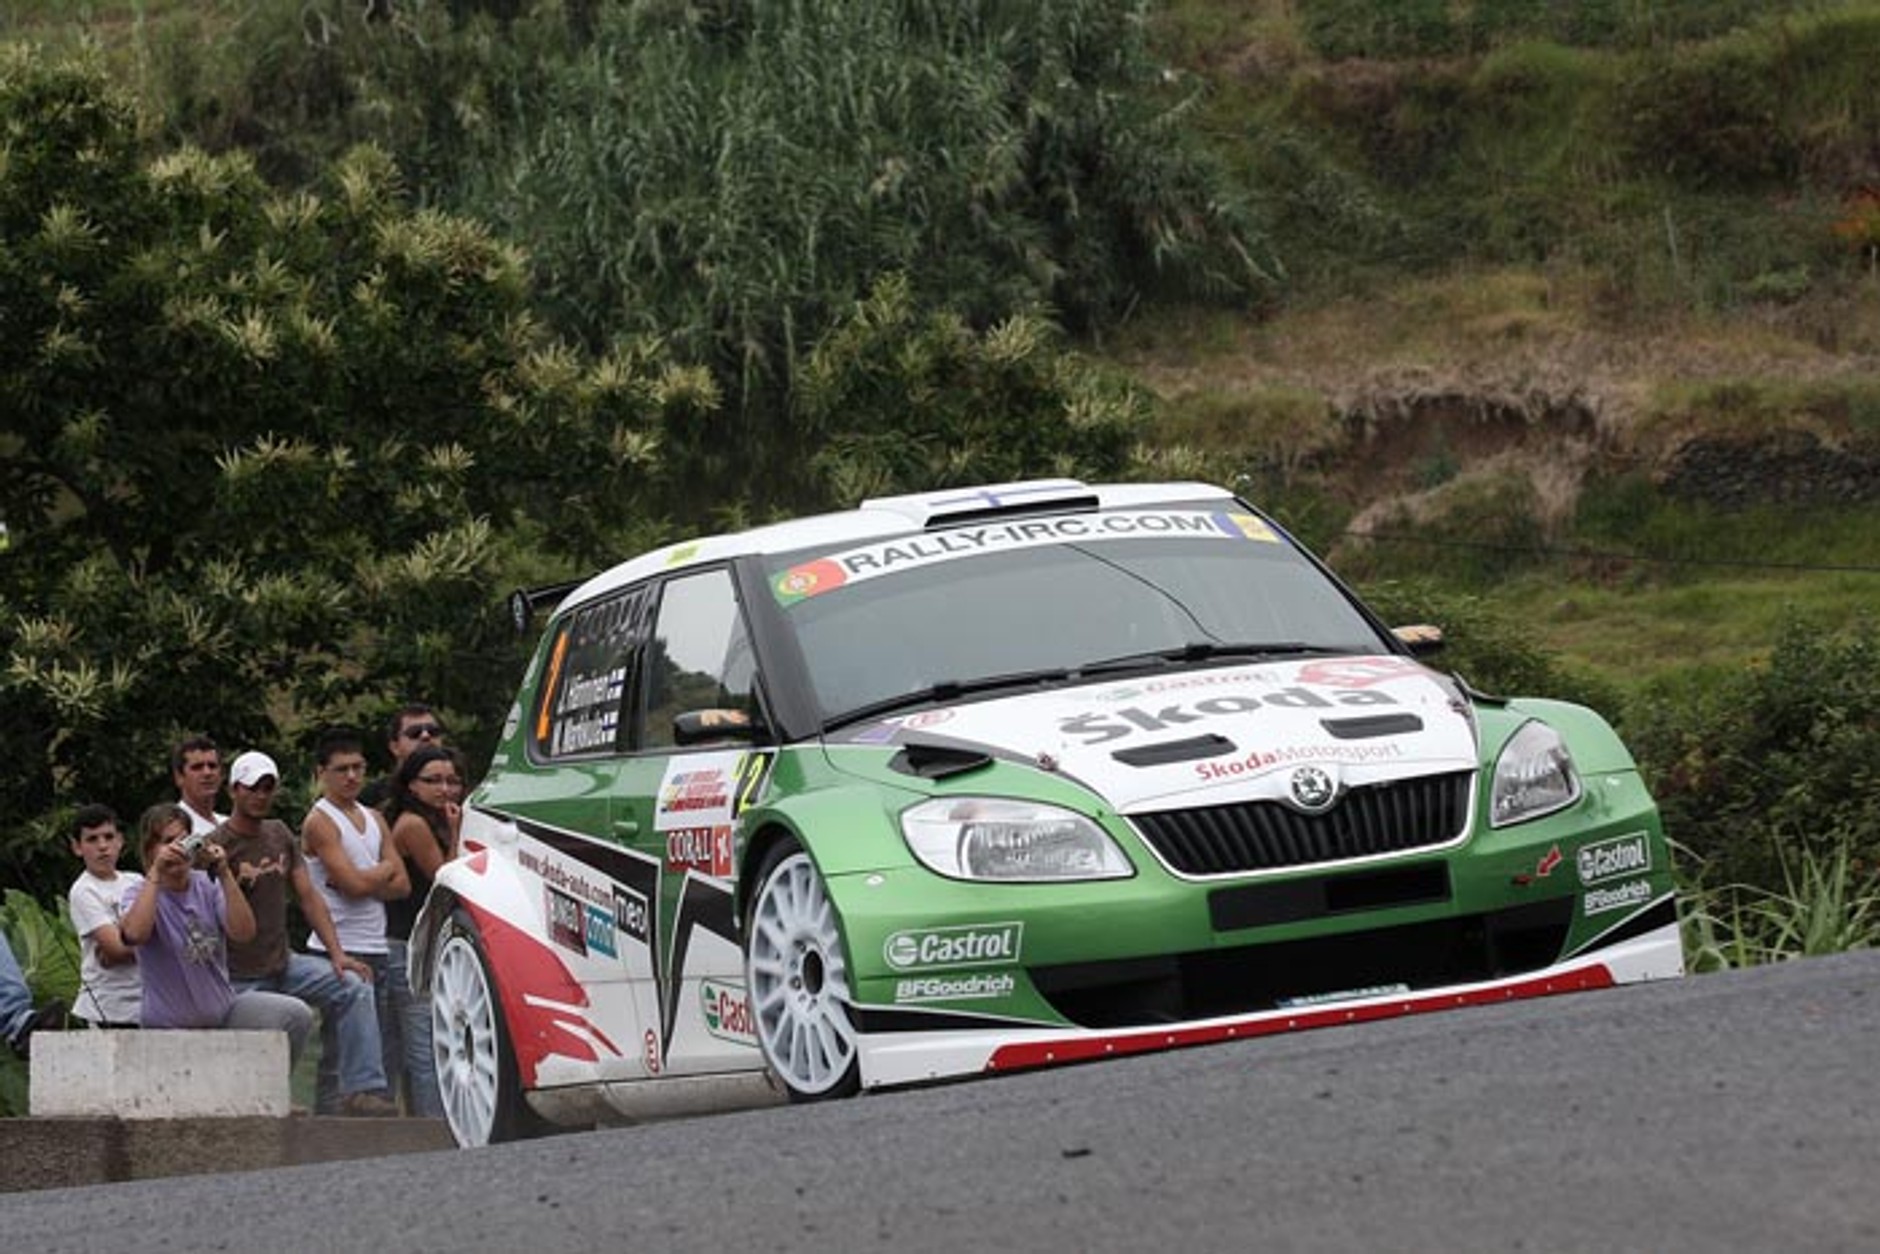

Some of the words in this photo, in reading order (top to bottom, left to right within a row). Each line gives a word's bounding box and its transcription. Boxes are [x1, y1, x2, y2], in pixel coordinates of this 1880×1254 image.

[842, 513, 1217, 574] RALLY-IRC.COM
[739, 753, 767, 812] 2
[667, 828, 712, 862] CORAL
[1595, 838, 1645, 876] Castrol
[615, 895, 646, 934] meo
[920, 929, 1012, 962] Castrol
[896, 974, 1014, 999] BFGoodrich
